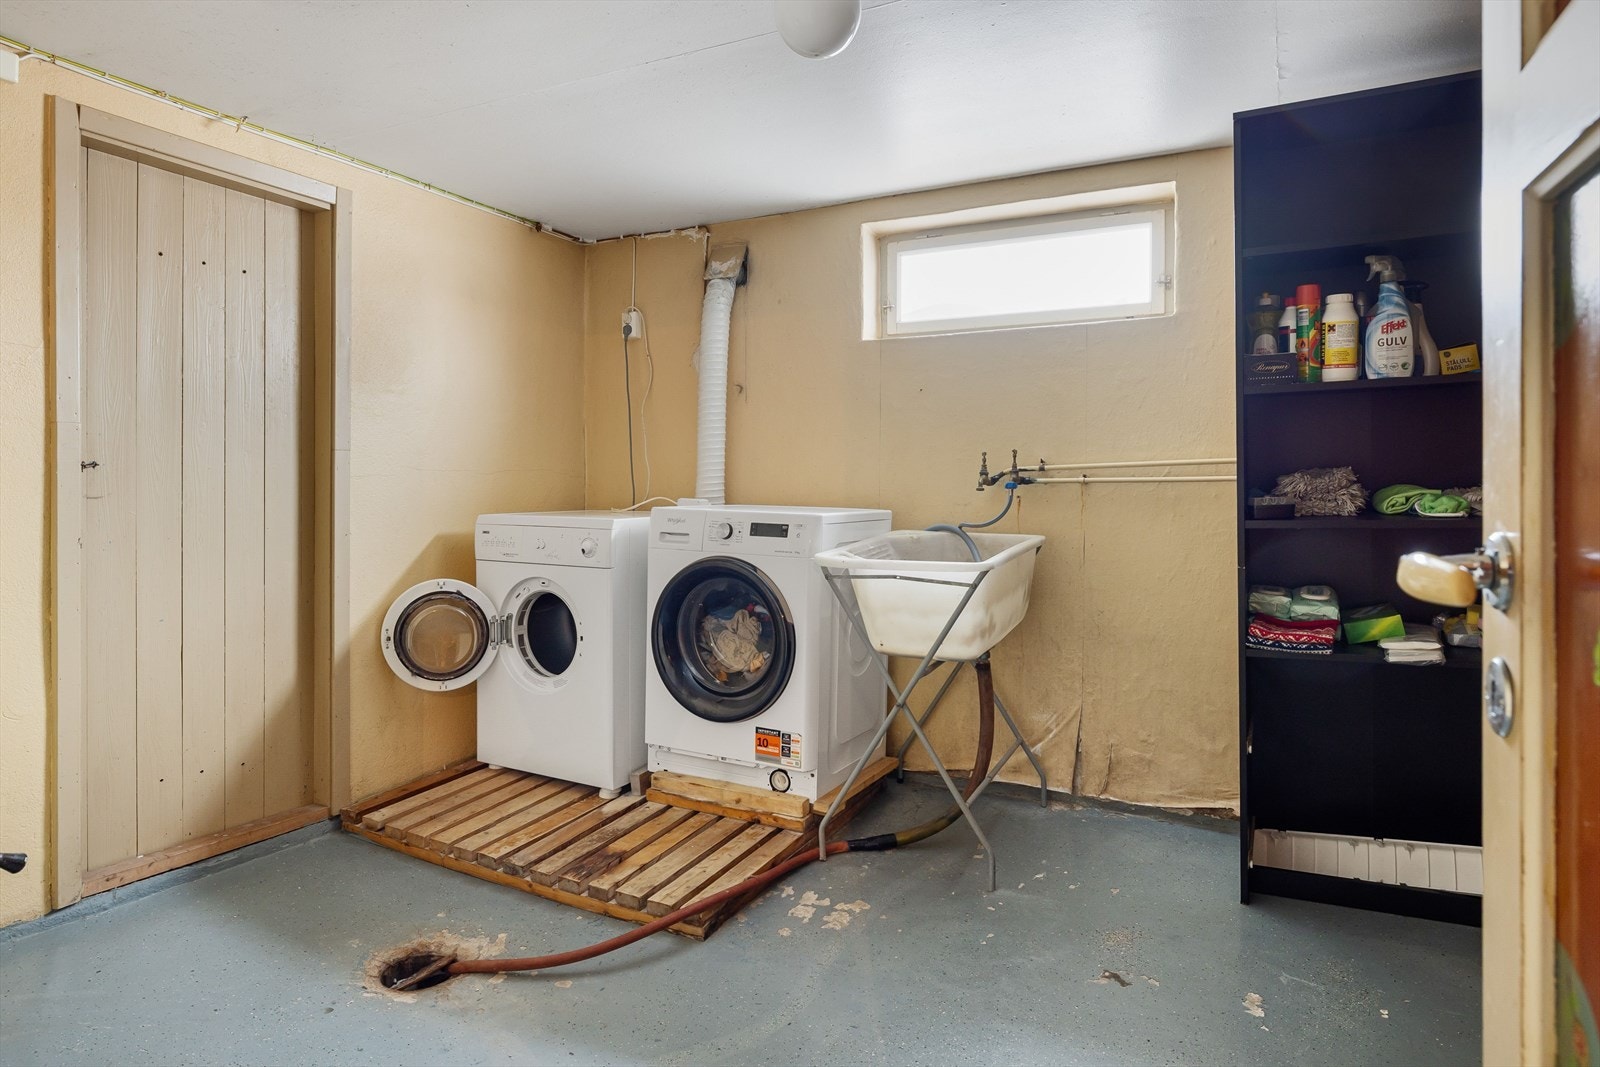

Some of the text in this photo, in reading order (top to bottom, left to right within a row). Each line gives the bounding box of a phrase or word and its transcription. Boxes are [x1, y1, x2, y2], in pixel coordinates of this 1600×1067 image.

[1381, 319, 1407, 334] Effekt
[1377, 336, 1407, 347] GULV
[1446, 357, 1473, 366] STÅLULL-
[757, 737, 768, 748] 10
